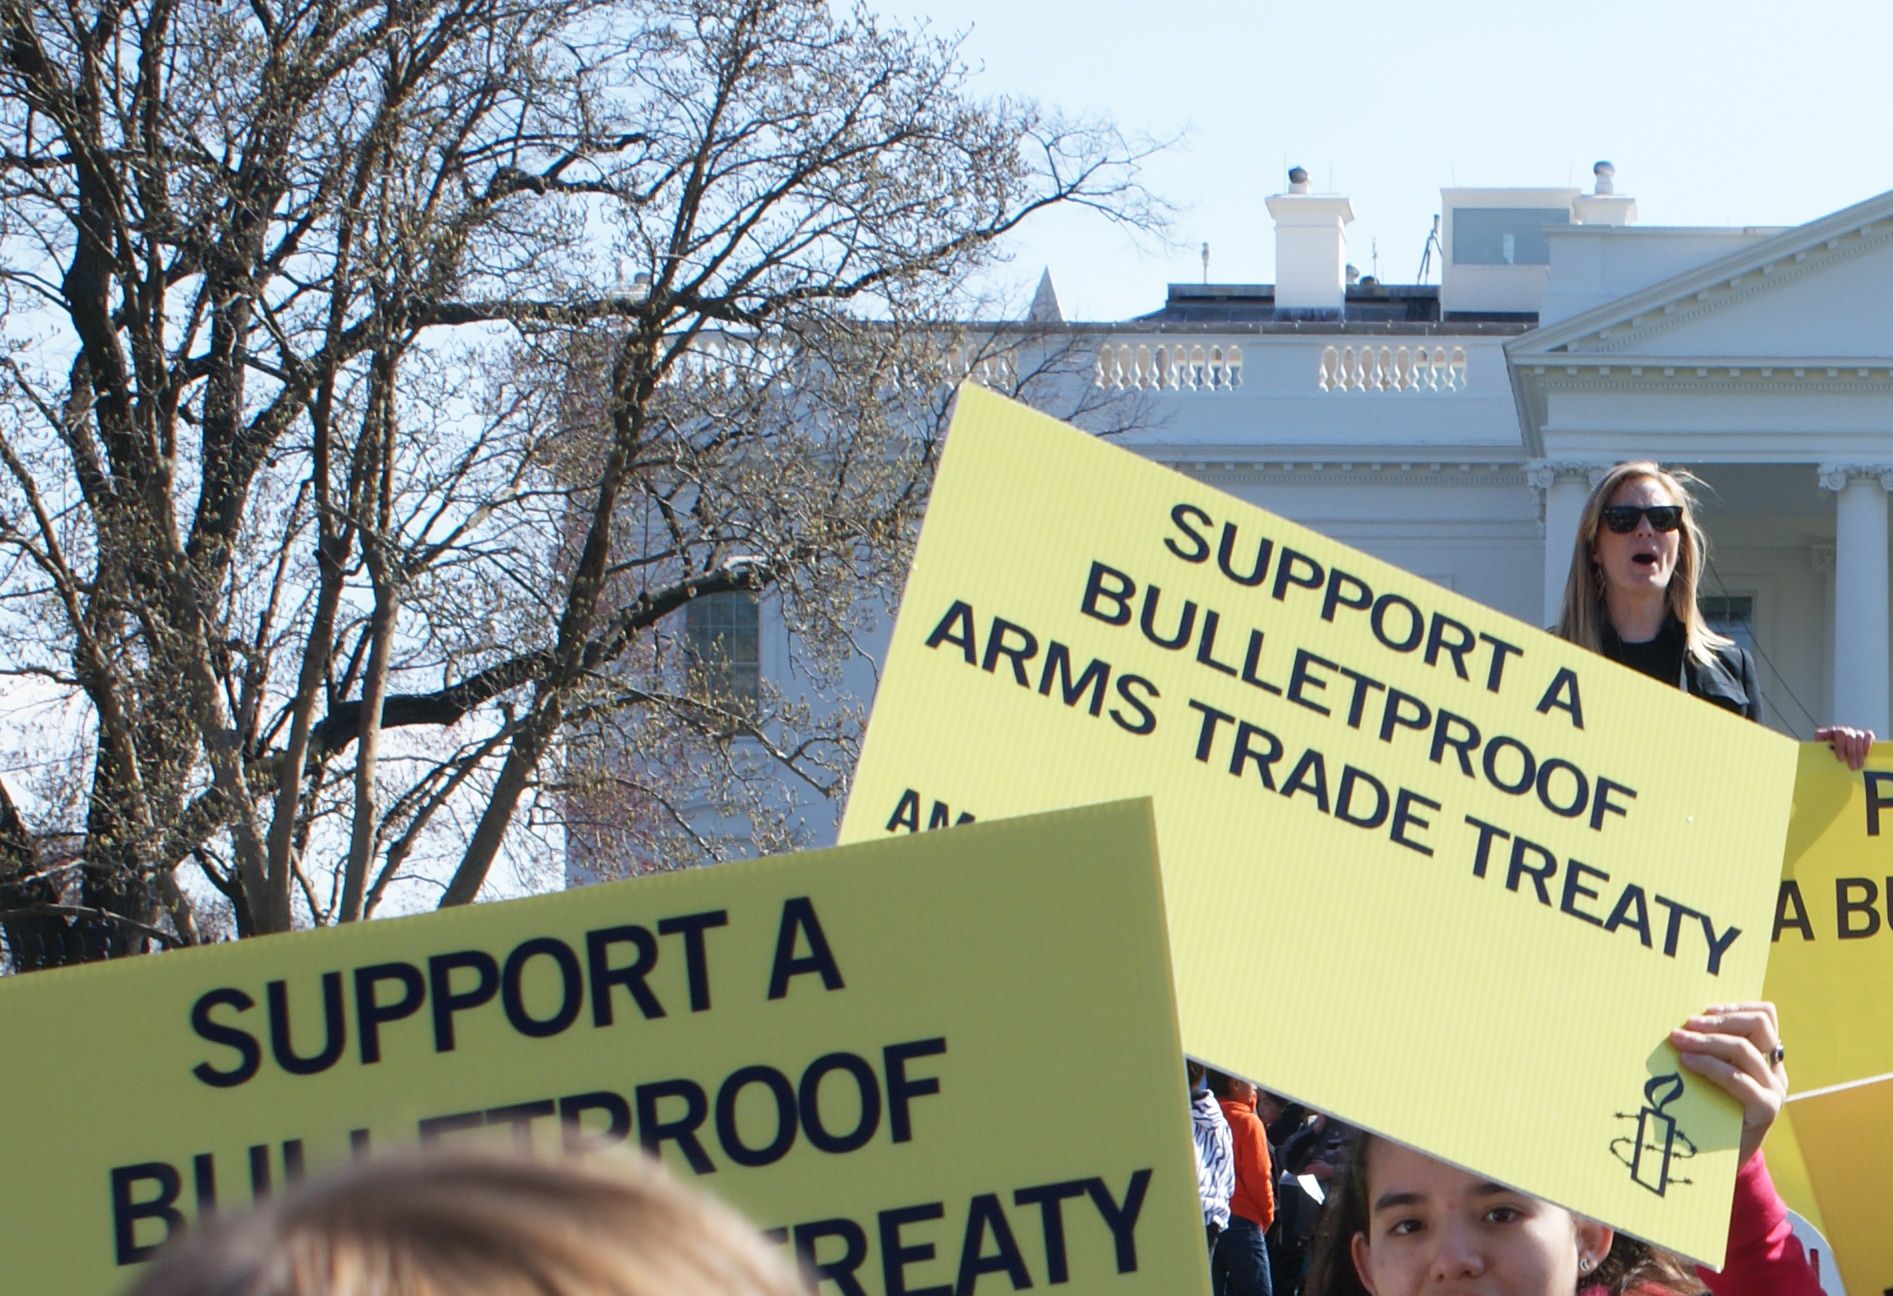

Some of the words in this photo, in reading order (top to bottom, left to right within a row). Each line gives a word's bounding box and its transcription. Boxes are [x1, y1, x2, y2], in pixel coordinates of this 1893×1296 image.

[1081, 561, 1638, 832] BULLETPROOF
[1163, 503, 1524, 694] SUPPORT
[1535, 667, 1586, 730] A
[925, 600, 1160, 736] ARMS
[1187, 698, 1442, 857] TRADE
[1463, 814, 1742, 977] TREATY
[190, 910, 728, 1087] SUPPORT
[767, 896, 845, 1000] A
[1771, 879, 1815, 943] A
[111, 1037, 948, 1266] BTPROOF
